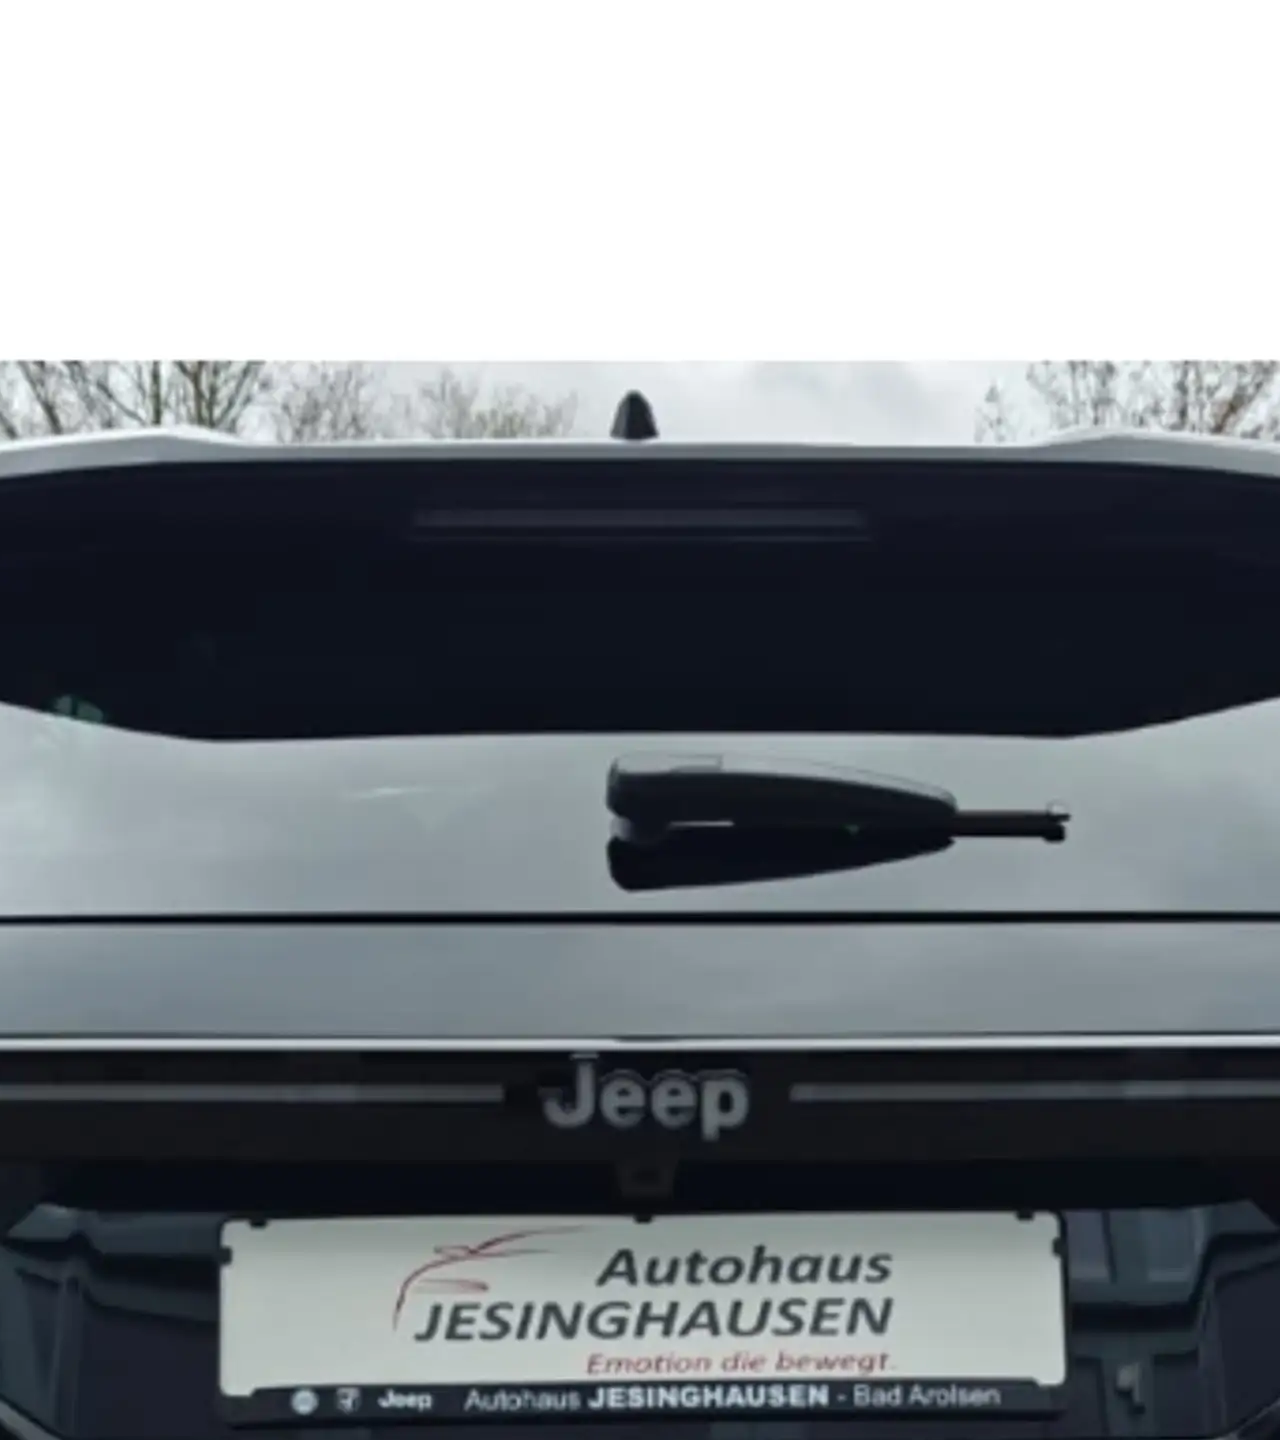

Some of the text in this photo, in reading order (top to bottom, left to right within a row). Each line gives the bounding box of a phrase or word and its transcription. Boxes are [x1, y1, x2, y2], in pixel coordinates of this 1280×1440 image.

[541, 1055, 750, 1141] Jeep
[596, 1244, 893, 1289] Autohaus
[414, 1297, 894, 1342] JESINGHAUSEN
[585, 1349, 898, 1376] Emotion die bewegt.
[376, 1388, 433, 1411] Jeep
[463, 1387, 582, 1412] Autohaus
[586, 1384, 831, 1410] JESINGHAUSEN
[852, 1383, 902, 1408] Bad
[909, 1383, 1003, 1408] Arolsen
